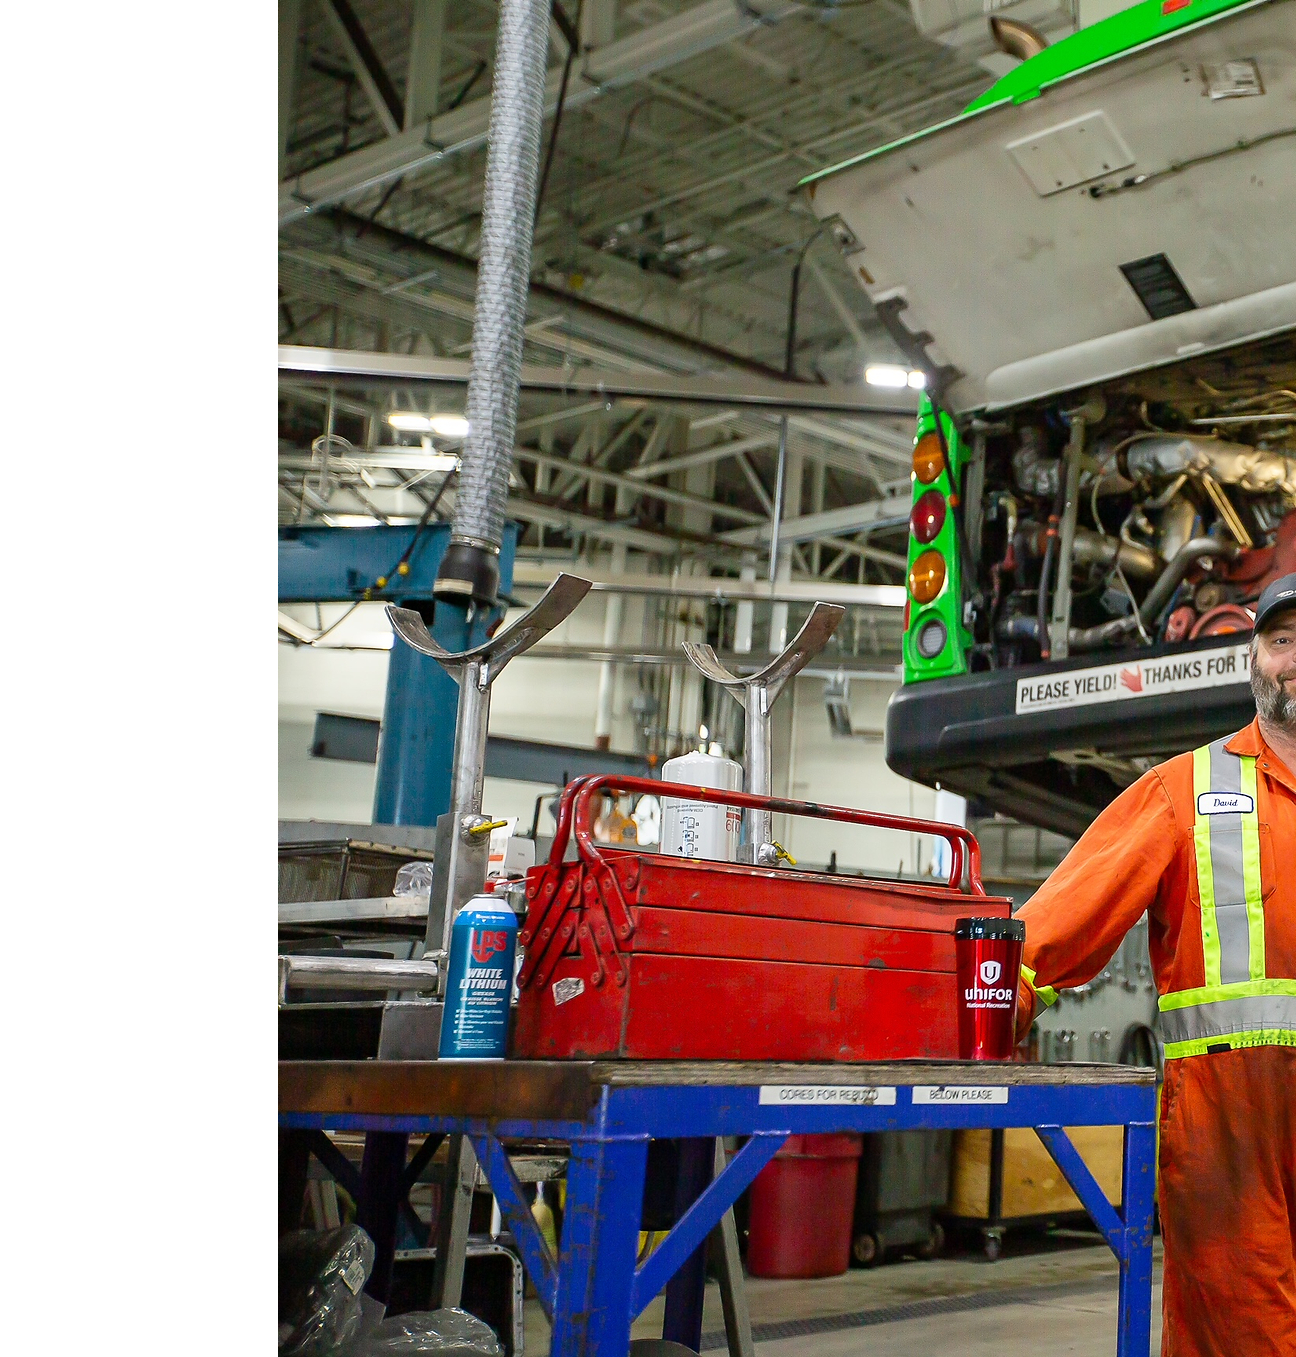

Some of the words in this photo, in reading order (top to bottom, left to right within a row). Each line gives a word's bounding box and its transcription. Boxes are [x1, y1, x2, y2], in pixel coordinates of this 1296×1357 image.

[1020, 680, 1069, 703] PLEASE
[1074, 673, 1117, 696] YIELD!
[1144, 660, 1201, 685] THANKS
[1206, 655, 1236, 676] FOR
[1213, 798, 1239, 807] David
[472, 931, 508, 955] LPS
[467, 968, 504, 979] WHITE
[459, 979, 508, 989] LITHIUM
[779, 1089, 815, 1101] CORES
[816, 1089, 837, 1101] FOR
[930, 1089, 959, 1100] BELOW
[961, 1089, 993, 1100] PLEASE
